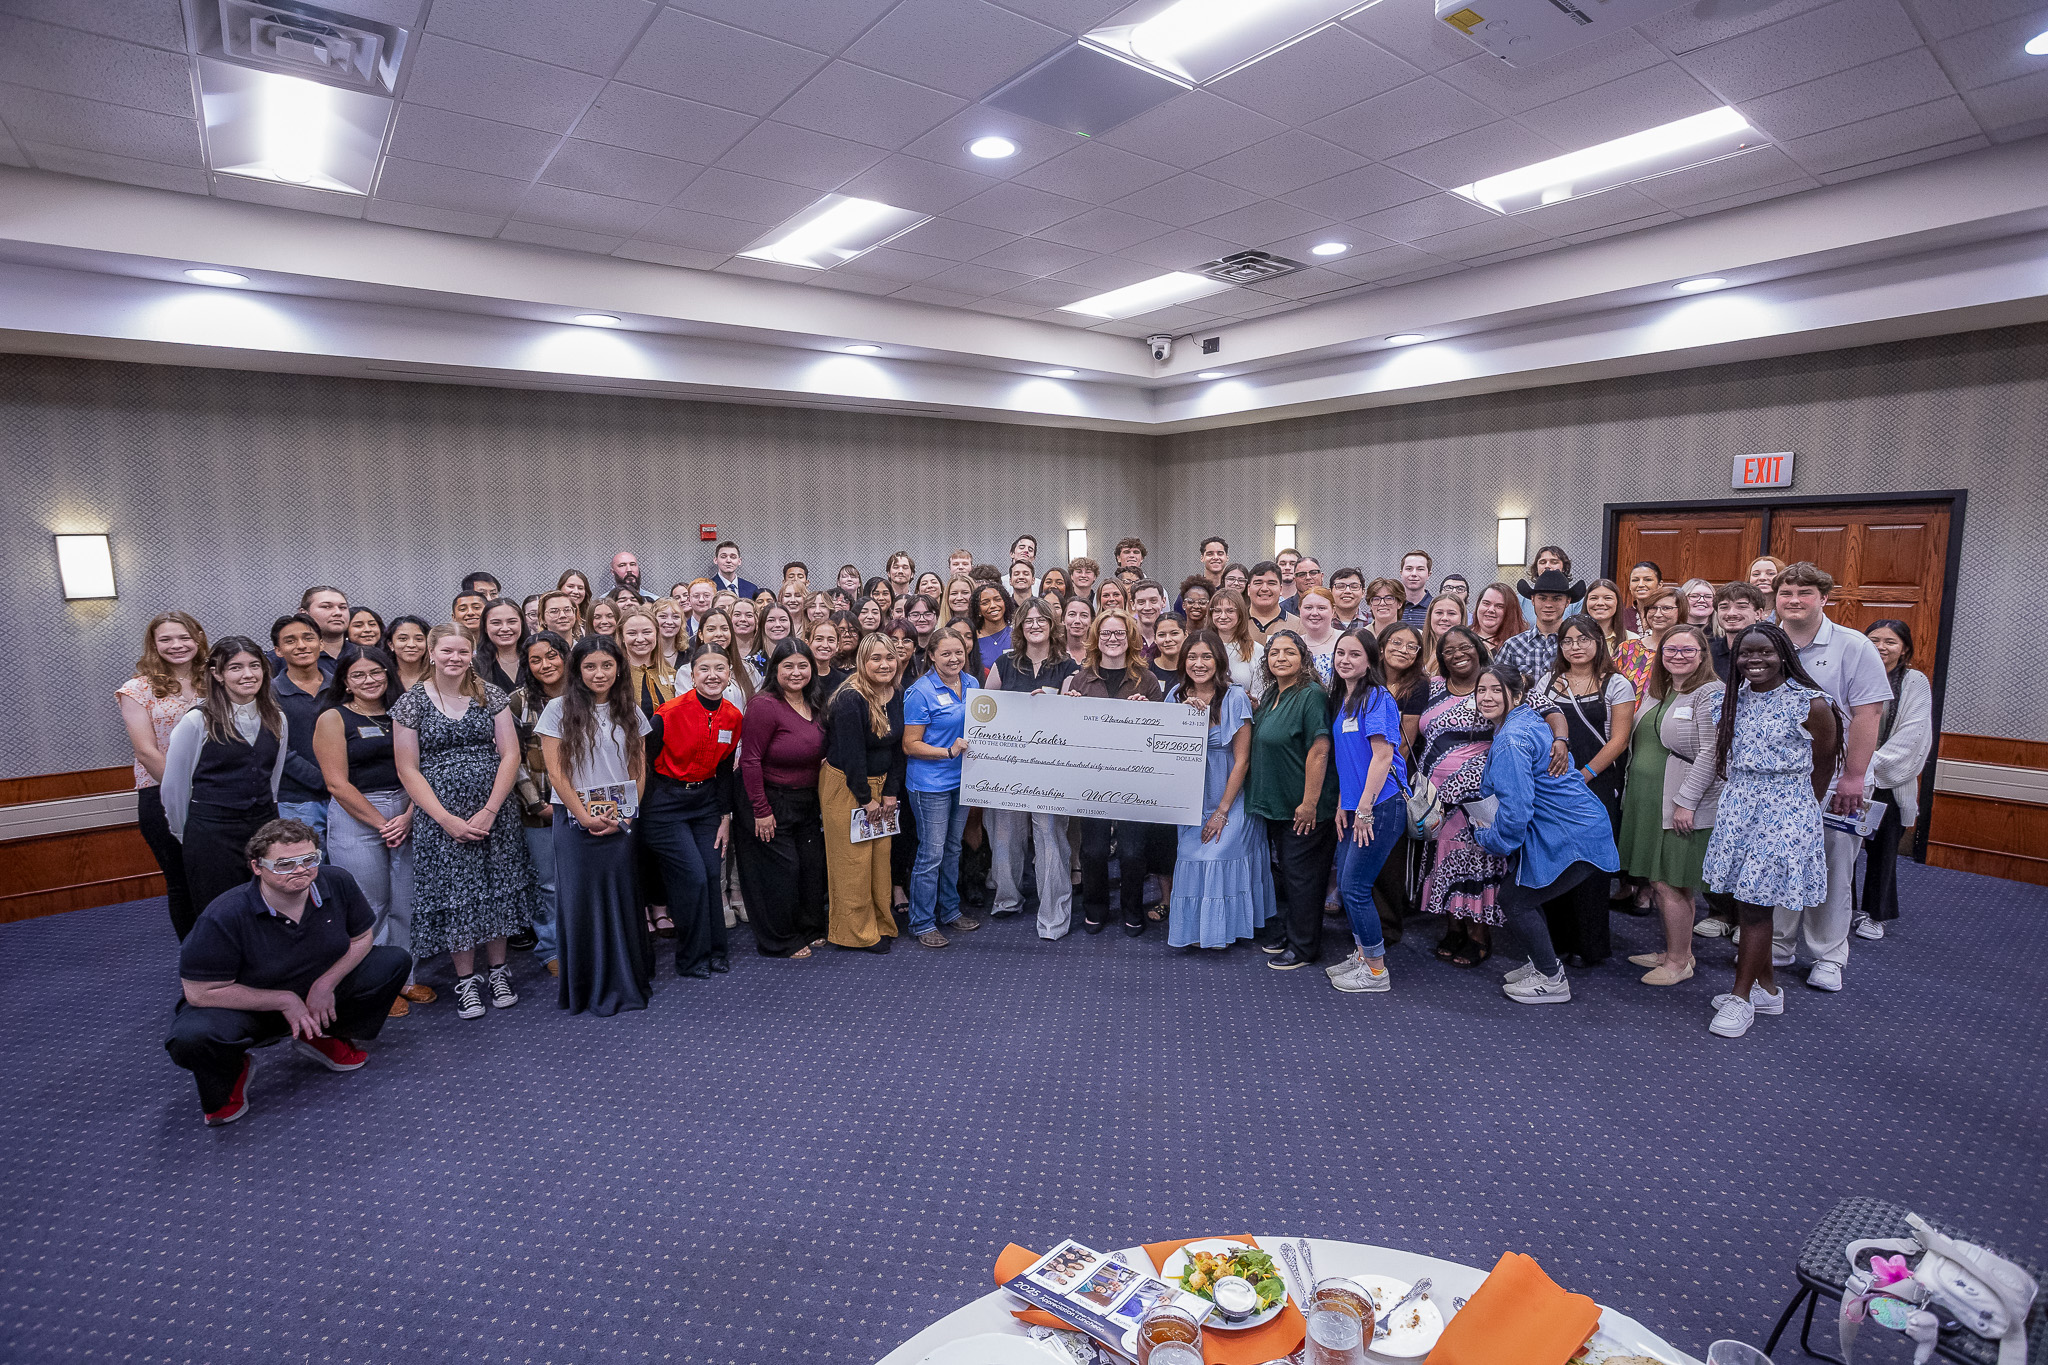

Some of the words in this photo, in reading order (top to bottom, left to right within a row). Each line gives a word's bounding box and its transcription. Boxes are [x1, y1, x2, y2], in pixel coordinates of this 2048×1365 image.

[1743, 456, 1784, 484] EXIT
[1100, 713, 1134, 724] November
[1141, 718, 1162, 726] 2025
[1187, 708, 1206, 717] 1246
[967, 725, 1023, 742] Tomorrow's
[1026, 729, 1067, 746] Leaders
[966, 750, 985, 761] Eight
[984, 752, 1008, 762] hundred
[1065, 760, 1090, 768] hundred
[1175, 755, 1203, 763] DOLLARS
[975, 779, 1010, 792] Student
[1010, 782, 1065, 800] Scholarships
[1081, 788, 1122, 804] MCC
[1121, 792, 1159, 806] Donors
[1533, 985, 1548, 996] N
[1013, 1281, 1042, 1297] 2025
[1038, 1296, 1076, 1318] Appreciation
[1074, 1314, 1105, 1333] Luncheon
